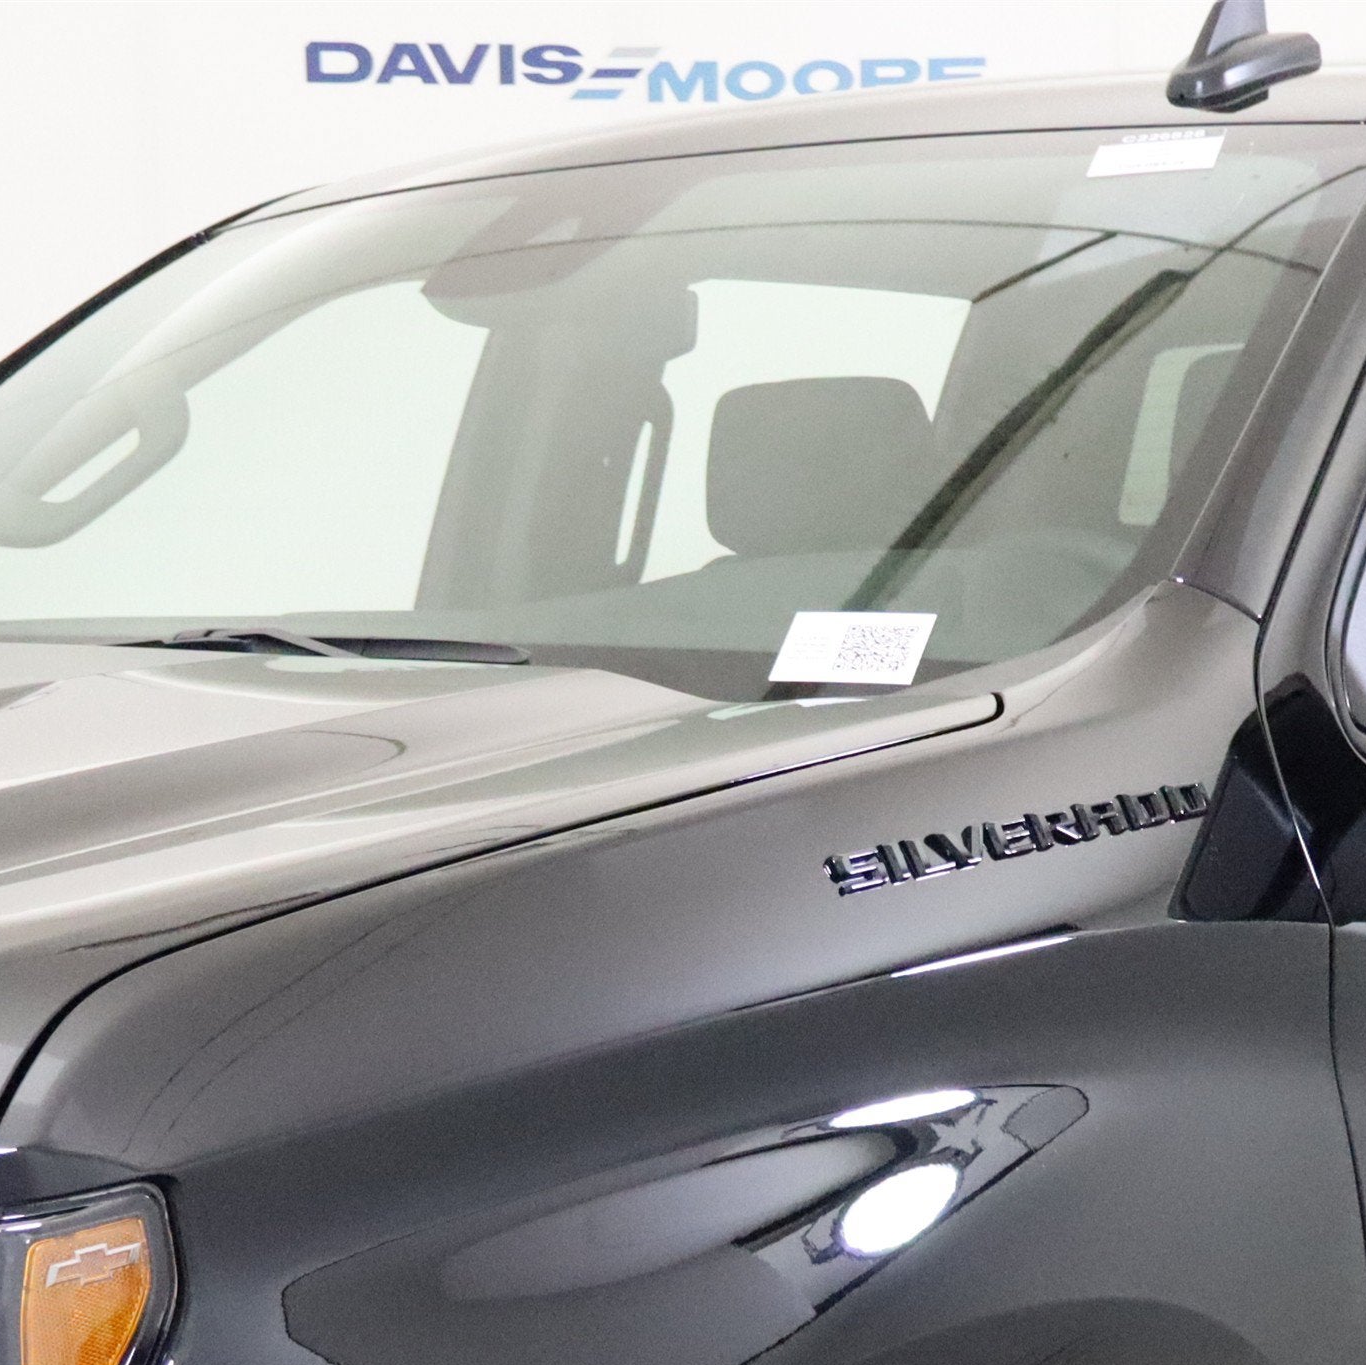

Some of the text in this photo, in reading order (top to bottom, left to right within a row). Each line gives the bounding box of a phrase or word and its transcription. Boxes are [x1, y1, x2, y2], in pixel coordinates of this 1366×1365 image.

[305, 41, 986, 102] DAVIS MOORE
[823, 783, 1212, 897] SILVERADO
